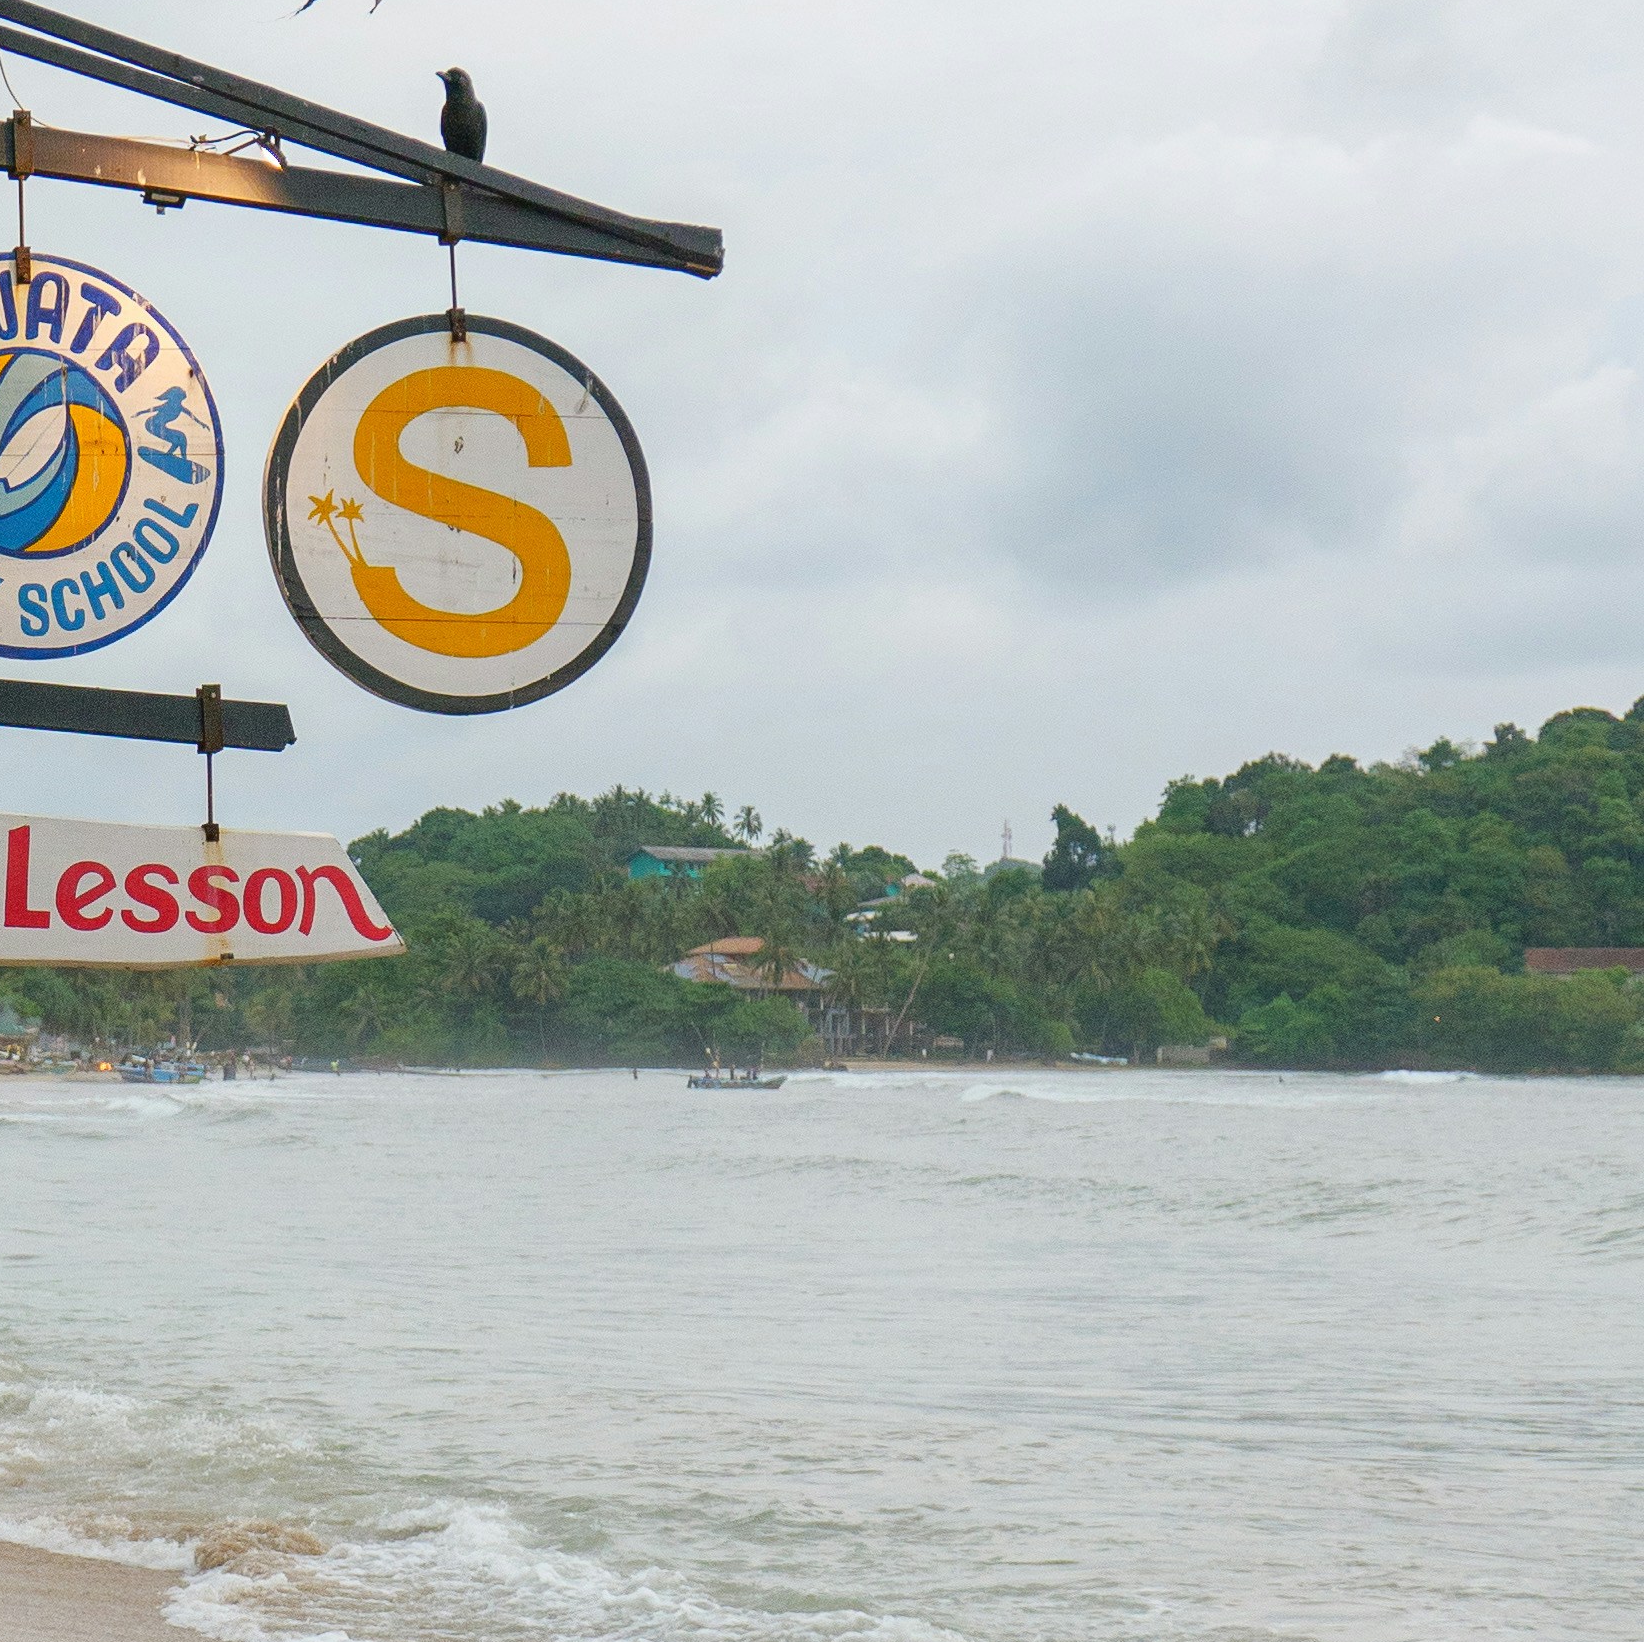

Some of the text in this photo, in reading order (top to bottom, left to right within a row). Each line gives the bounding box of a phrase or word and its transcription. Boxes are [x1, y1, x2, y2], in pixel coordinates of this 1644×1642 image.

[19, 500, 199, 638] SCHOOL
[351, 365, 573, 658] S
[3, 824, 393, 941] Lesson
